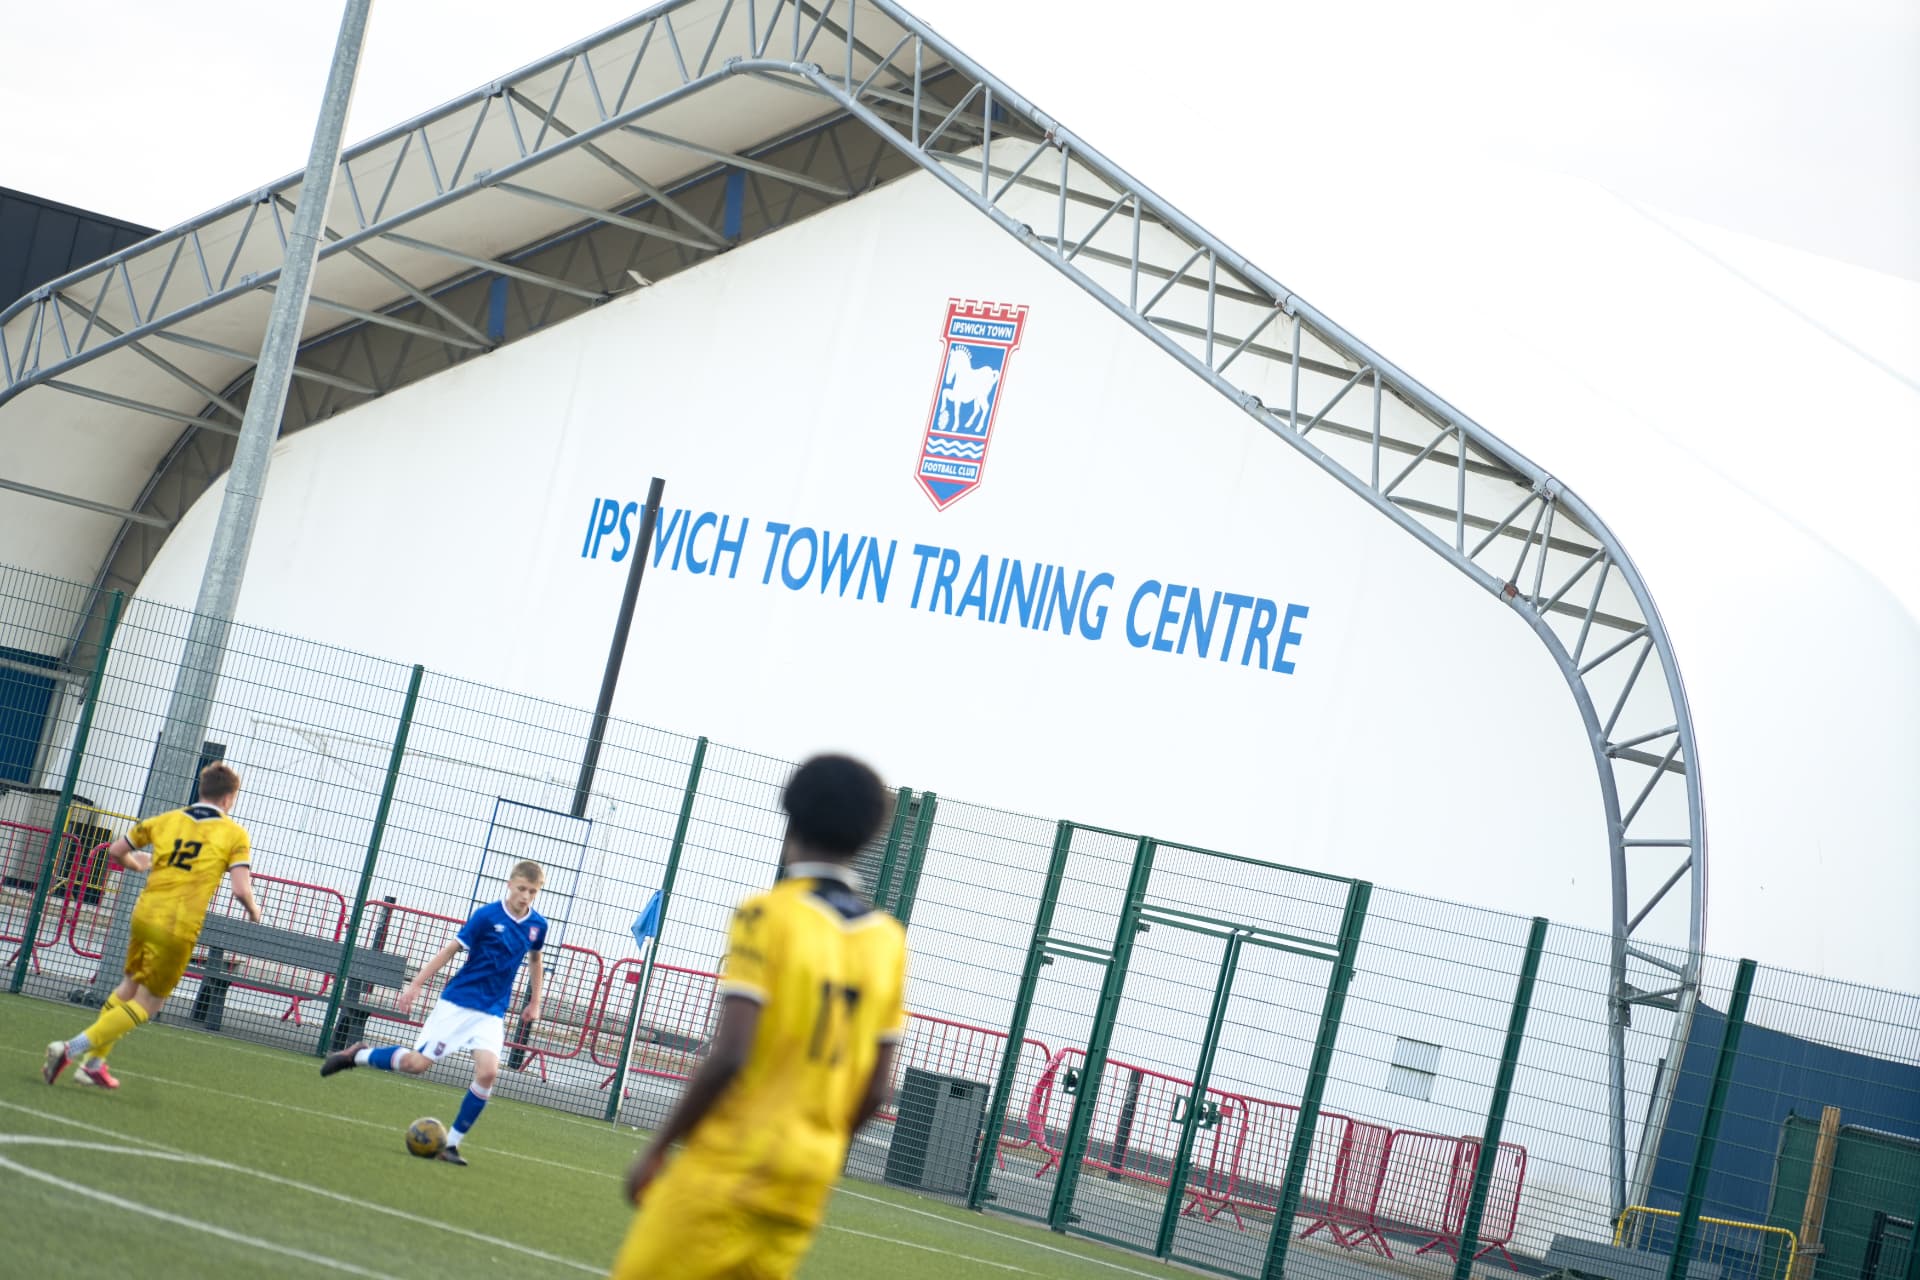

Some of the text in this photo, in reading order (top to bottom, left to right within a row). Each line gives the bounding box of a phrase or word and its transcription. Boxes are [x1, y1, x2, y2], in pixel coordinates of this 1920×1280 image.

[952, 321, 1013, 339] IPSWICH TOWN
[924, 461, 976, 478] FOOTBALL CLUB
[762, 521, 898, 604] TOWN
[910, 544, 1115, 641] TRAINING
[1125, 579, 1310, 675] CENTRE
[168, 838, 202, 871] 12
